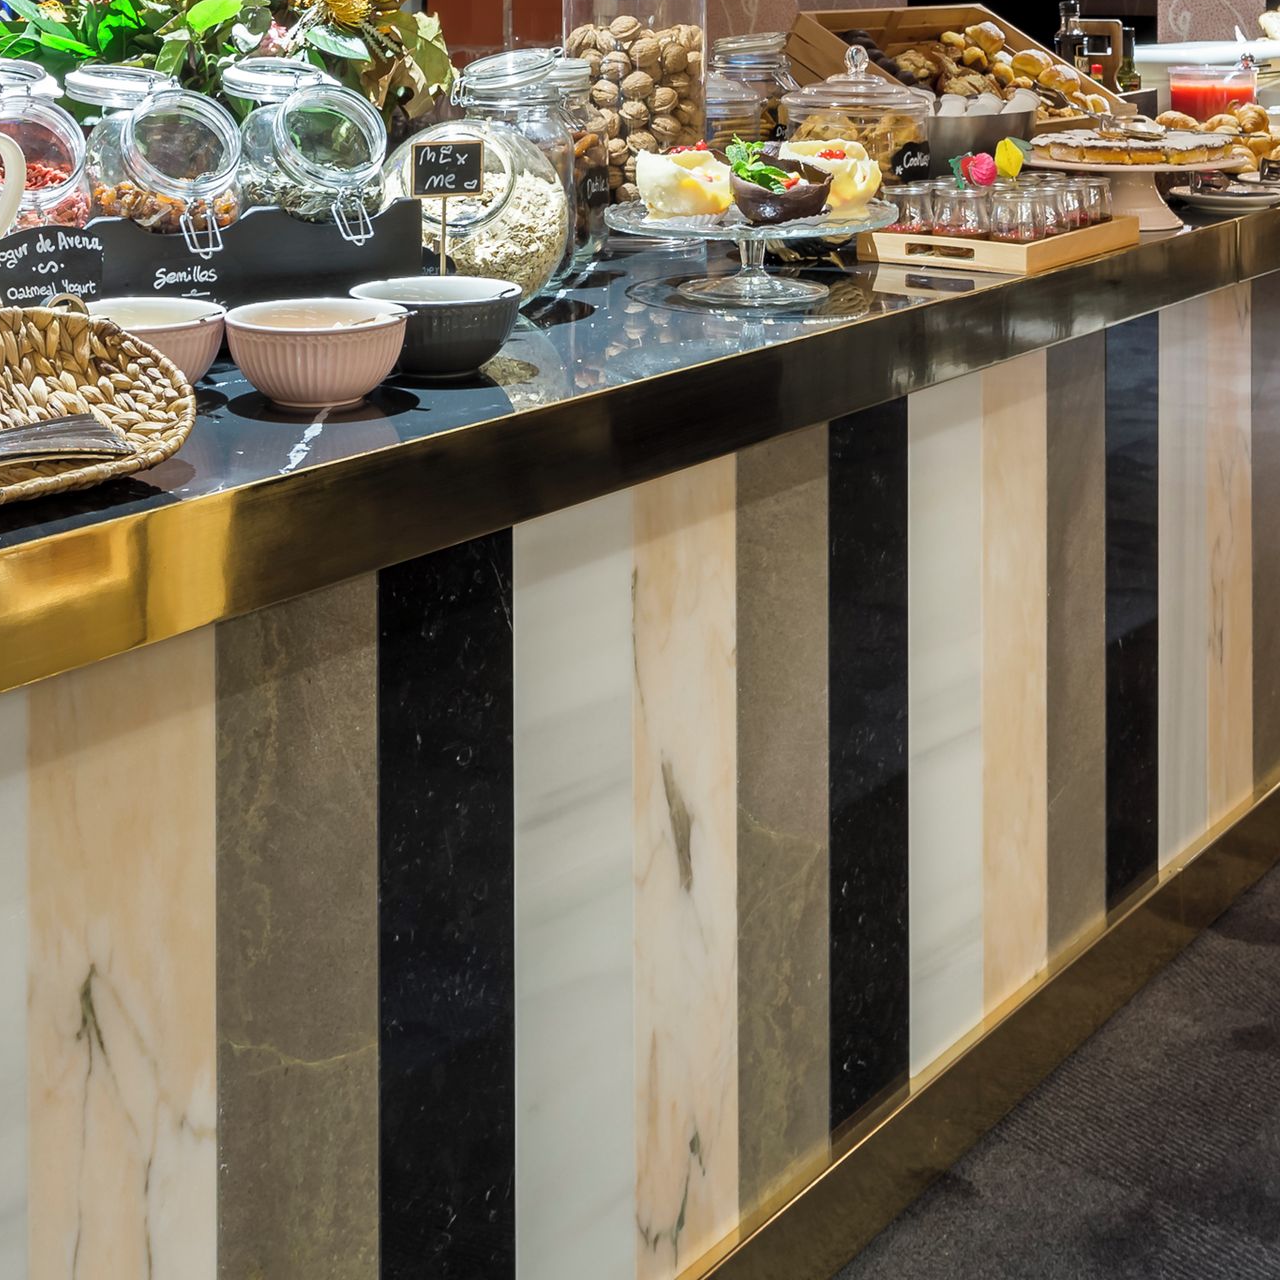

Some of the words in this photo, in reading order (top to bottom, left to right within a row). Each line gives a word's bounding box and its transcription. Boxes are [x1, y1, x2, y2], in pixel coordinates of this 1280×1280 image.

[35, 233, 56, 253] de
[57, 231, 103, 251] Avena
[6, 281, 57, 300] Oatmeal
[61, 278, 97, 298] Yogurt
